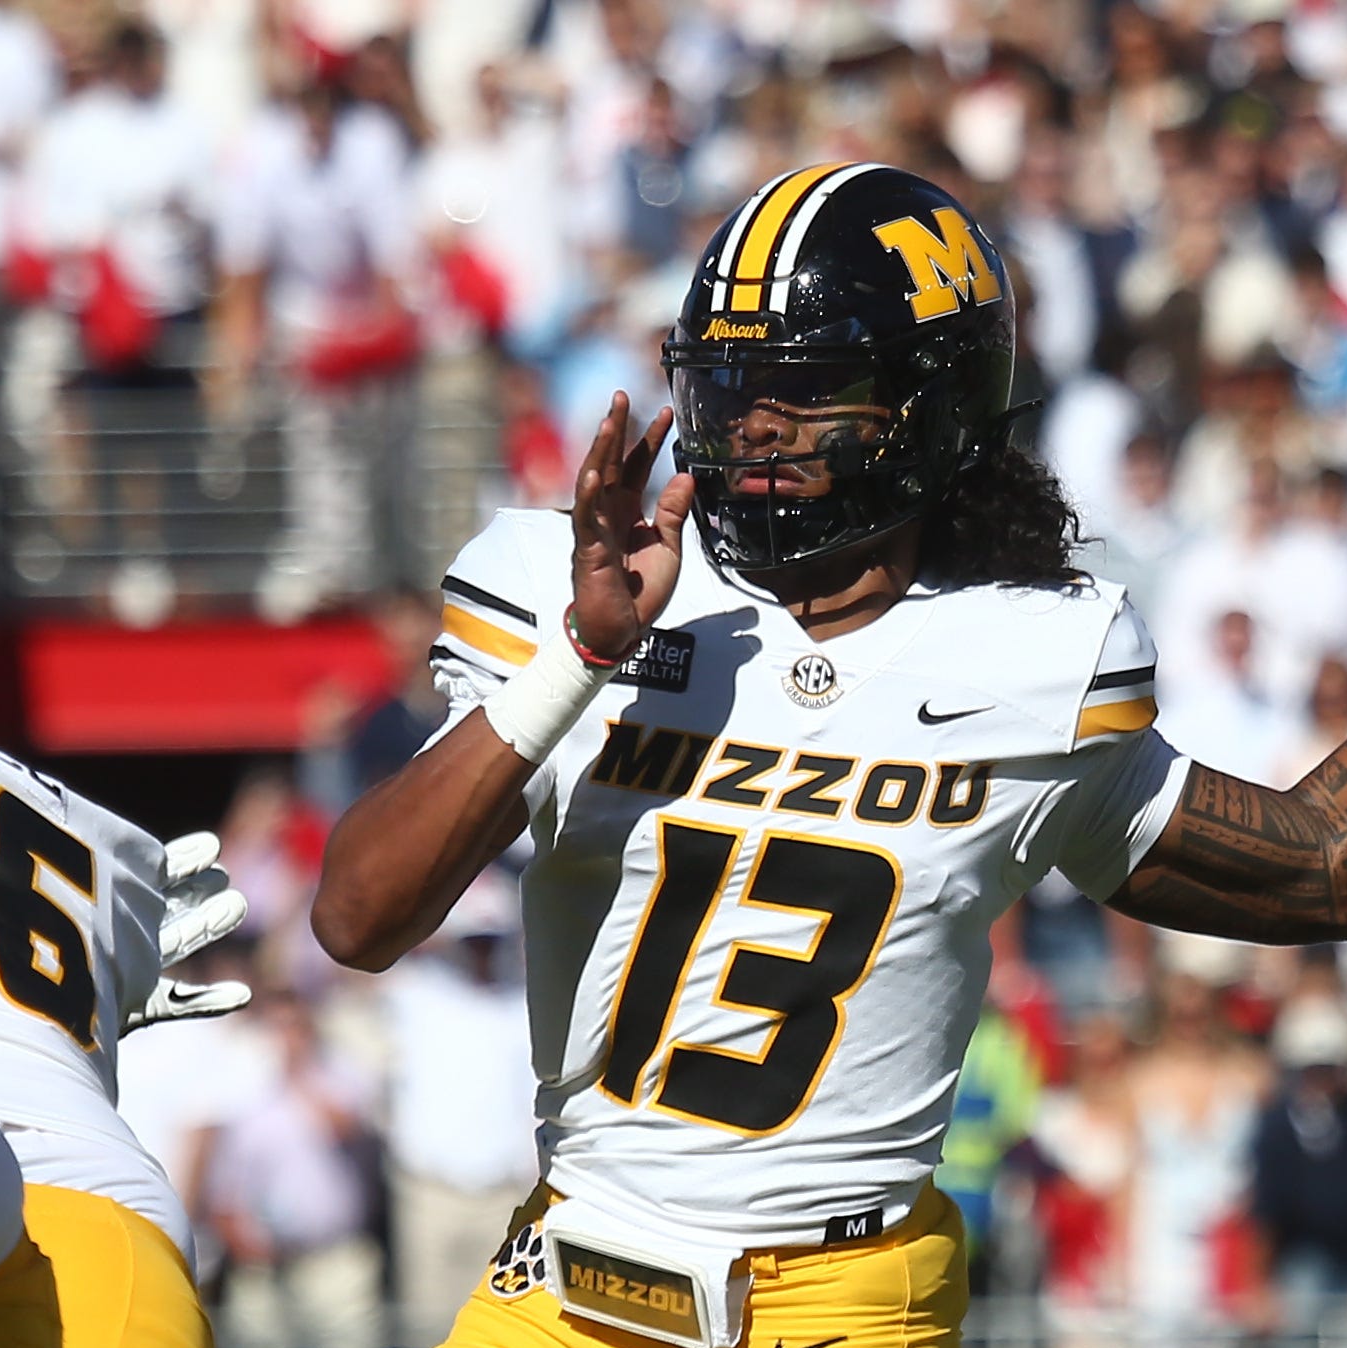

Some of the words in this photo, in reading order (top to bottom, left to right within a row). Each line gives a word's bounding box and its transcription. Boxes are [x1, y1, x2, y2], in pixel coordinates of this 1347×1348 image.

[872, 207, 1004, 323] M
[701, 317, 769, 341] Missouri
[621, 660, 683, 681] EALTH
[794, 657, 835, 694] SEC
[786, 684, 835, 709] GRADUATE
[590, 720, 993, 828] MIZZOU
[597, 814, 904, 1140] 13
[845, 1217, 867, 1238] M
[569, 1262, 692, 1318] MIZZOU
